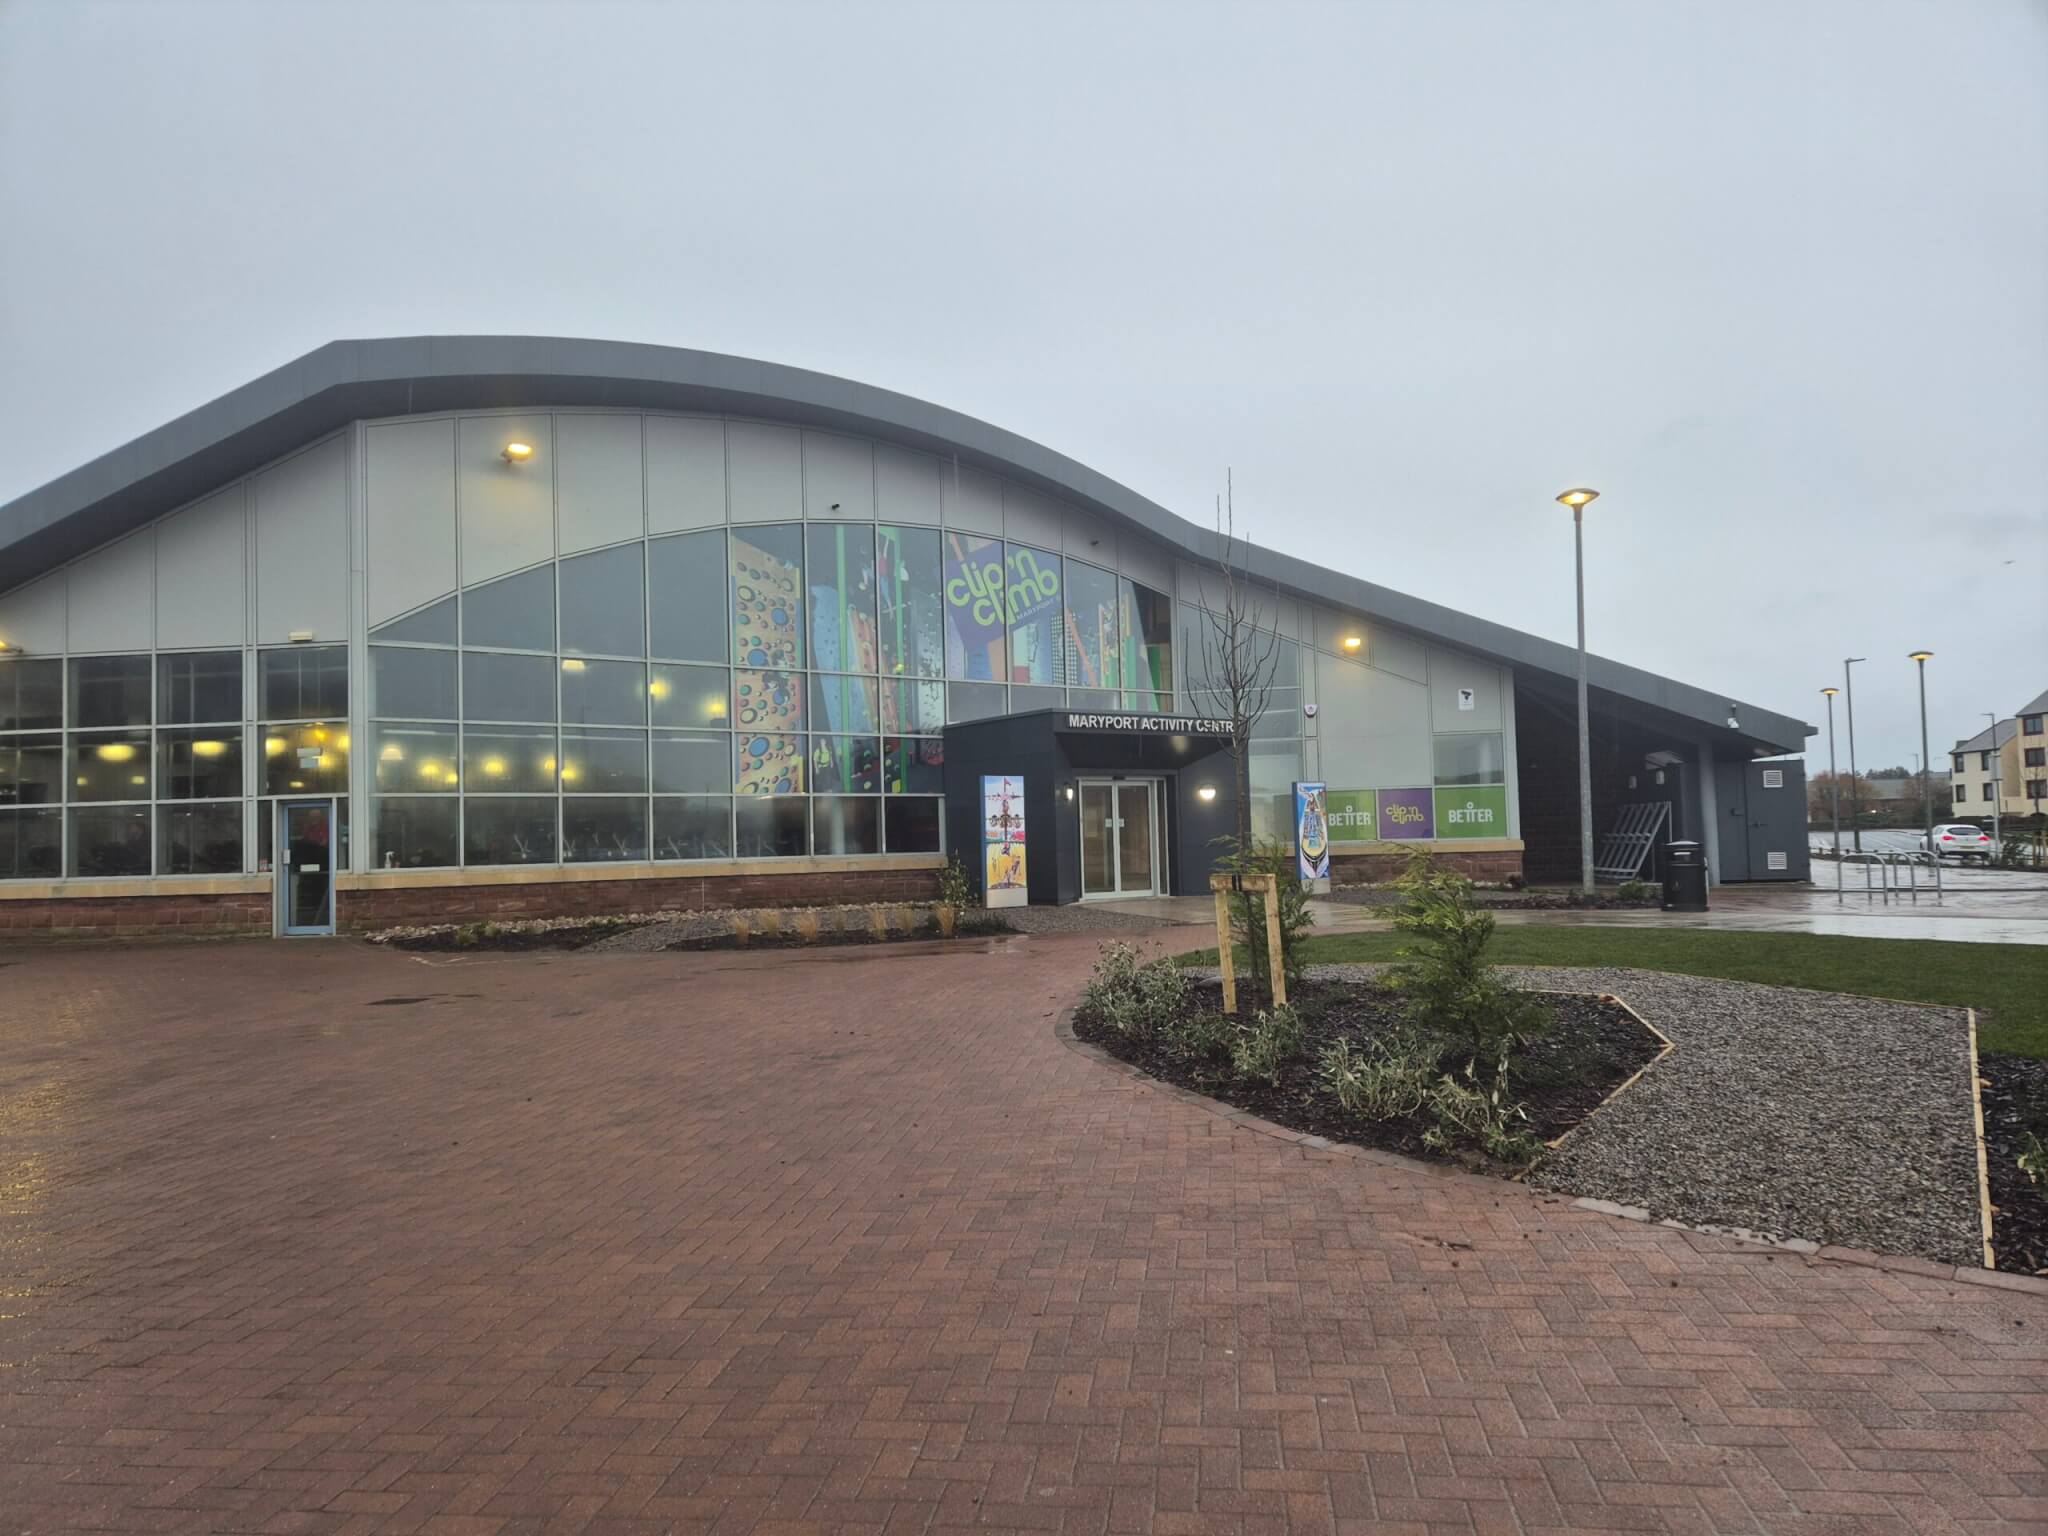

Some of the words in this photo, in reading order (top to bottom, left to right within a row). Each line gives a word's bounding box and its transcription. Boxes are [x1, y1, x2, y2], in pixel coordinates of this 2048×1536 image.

[946, 561, 1004, 614] clip
[972, 568, 1058, 625] climb
[1069, 714, 1139, 729] MARYPORT
[1141, 717, 1193, 731] ACTIVITY
[1196, 719, 1236, 732] CENTR
[1329, 805, 1371, 826] BETTER
[1385, 804, 1407, 818] clip
[1448, 802, 1493, 823] BETTER
